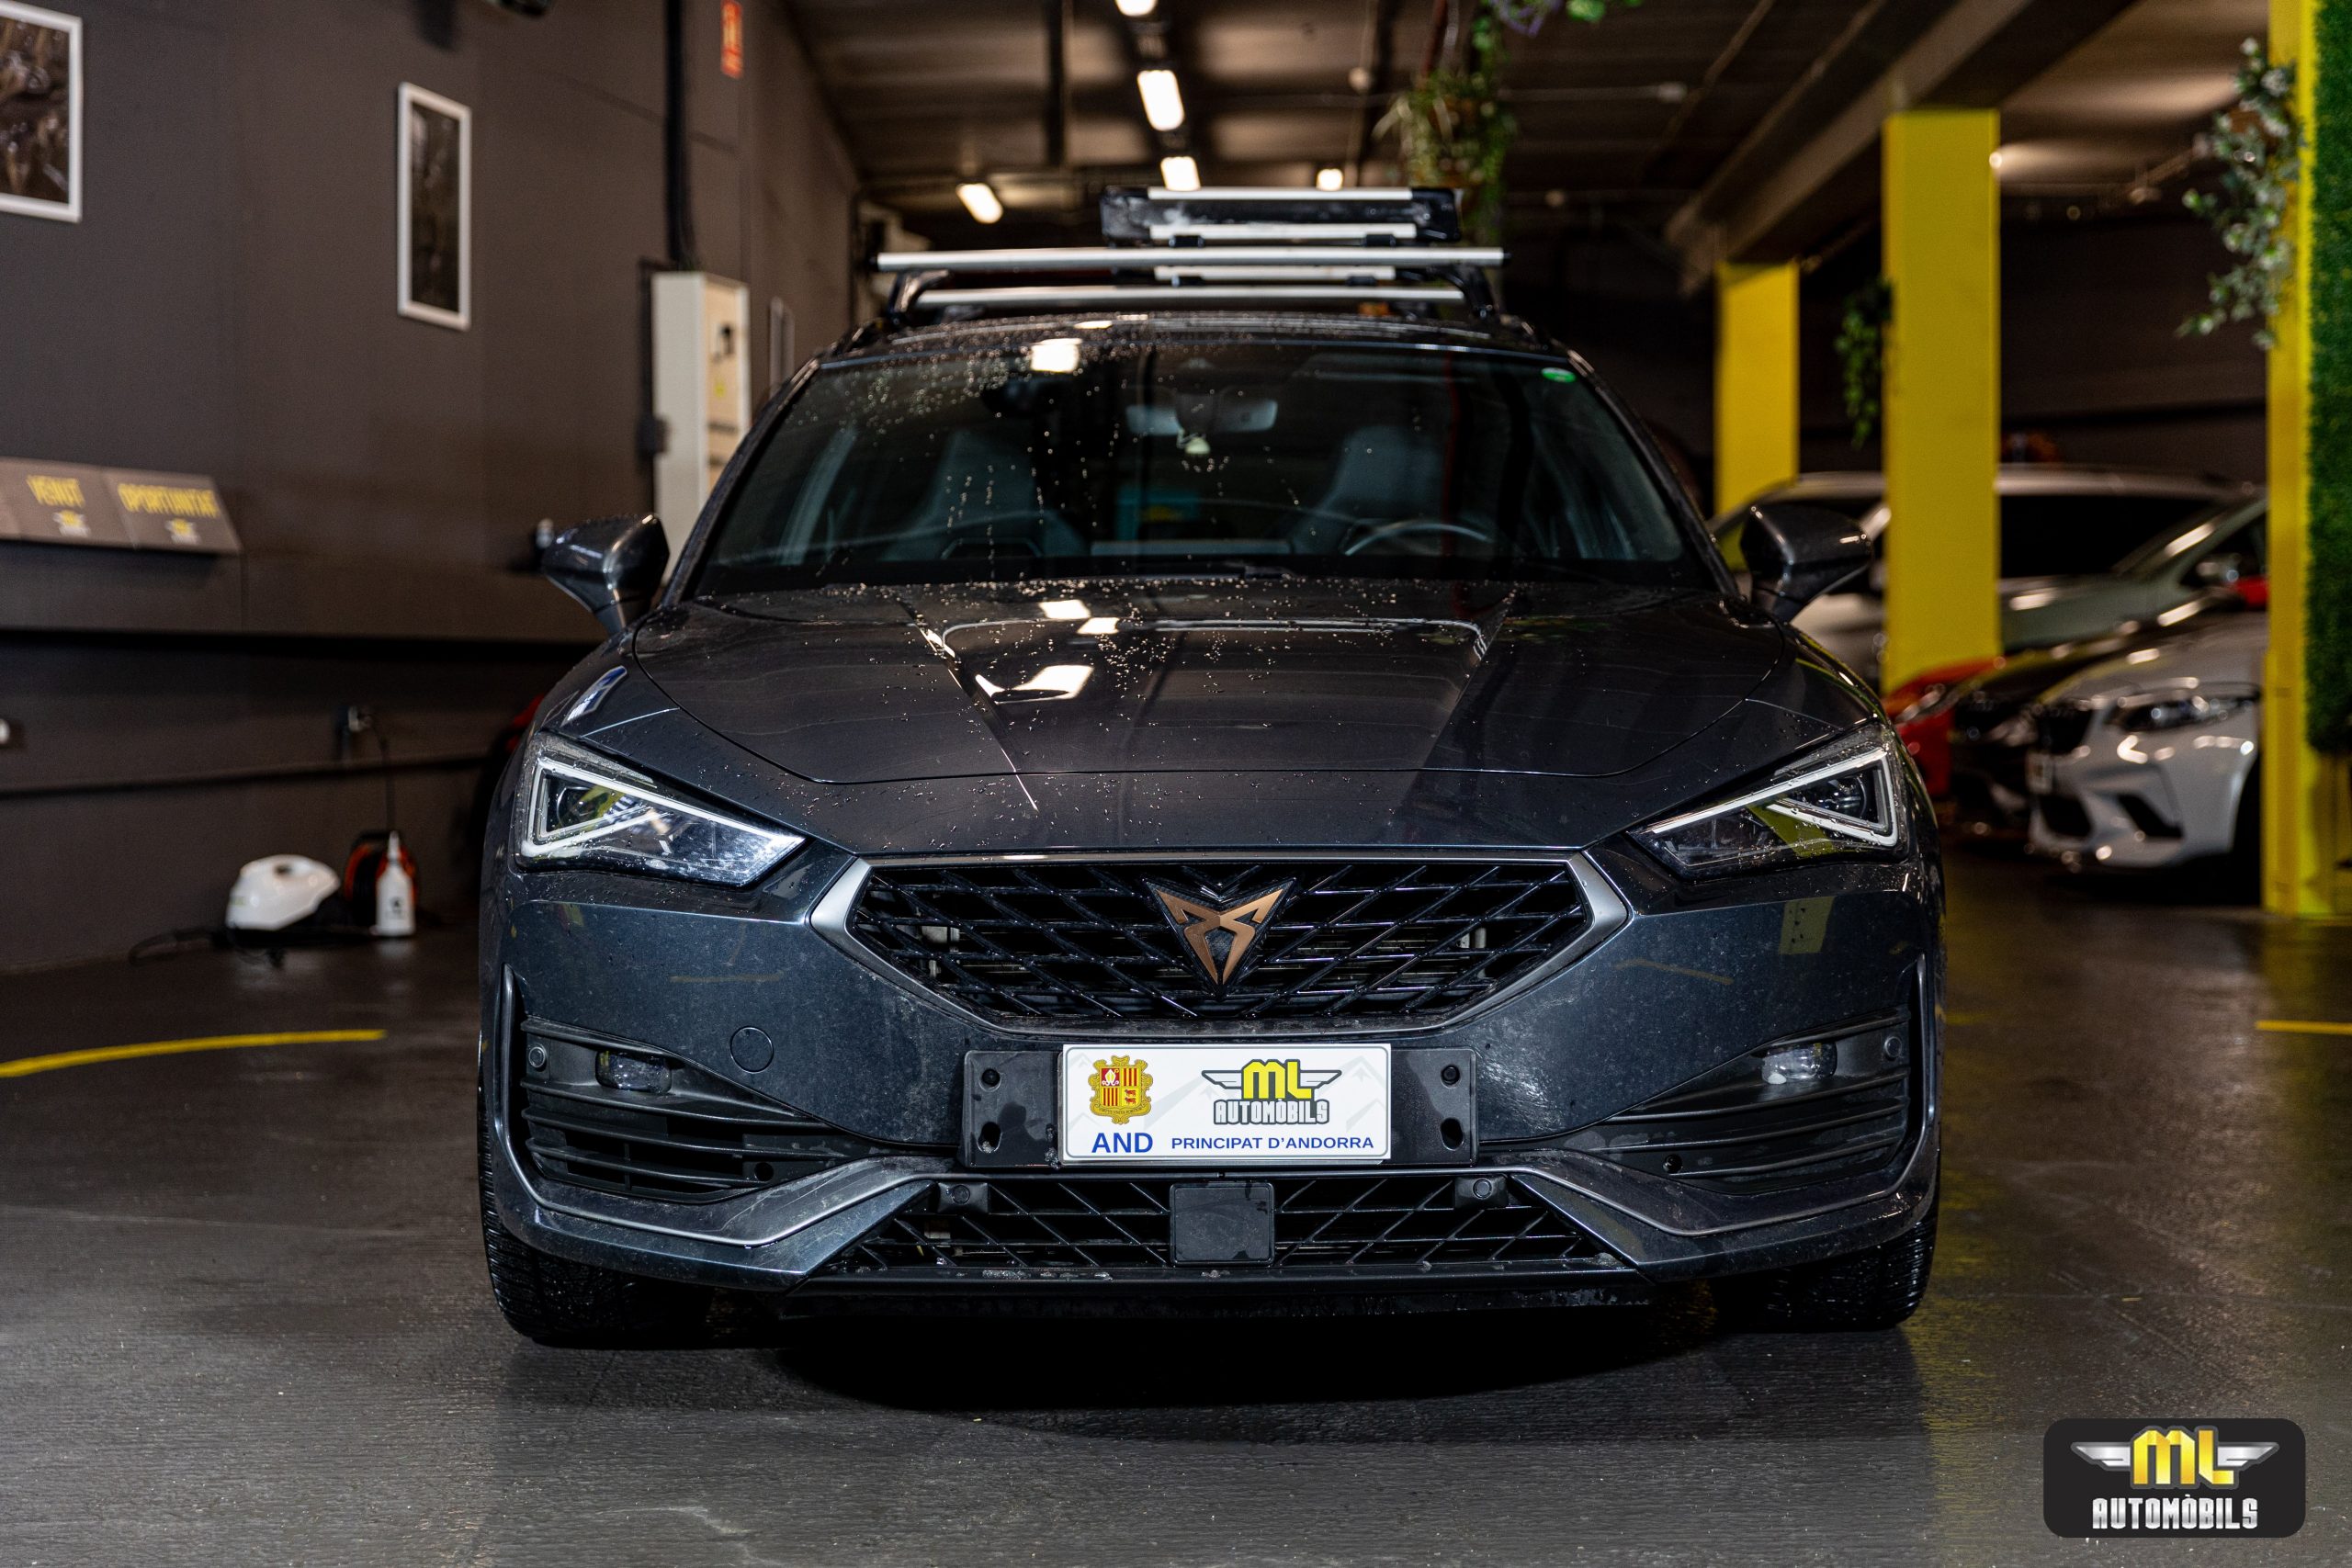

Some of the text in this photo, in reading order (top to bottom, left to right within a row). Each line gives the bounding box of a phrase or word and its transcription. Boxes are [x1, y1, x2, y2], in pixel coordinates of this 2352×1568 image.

[1242, 1060, 1315, 1100] ML
[1214, 1099, 1329, 1124] AUTOMÒBILS
[1091, 1133, 1154, 1154] AND
[1171, 1136, 1374, 1150] PRINCIPAT D'ANDORRA
